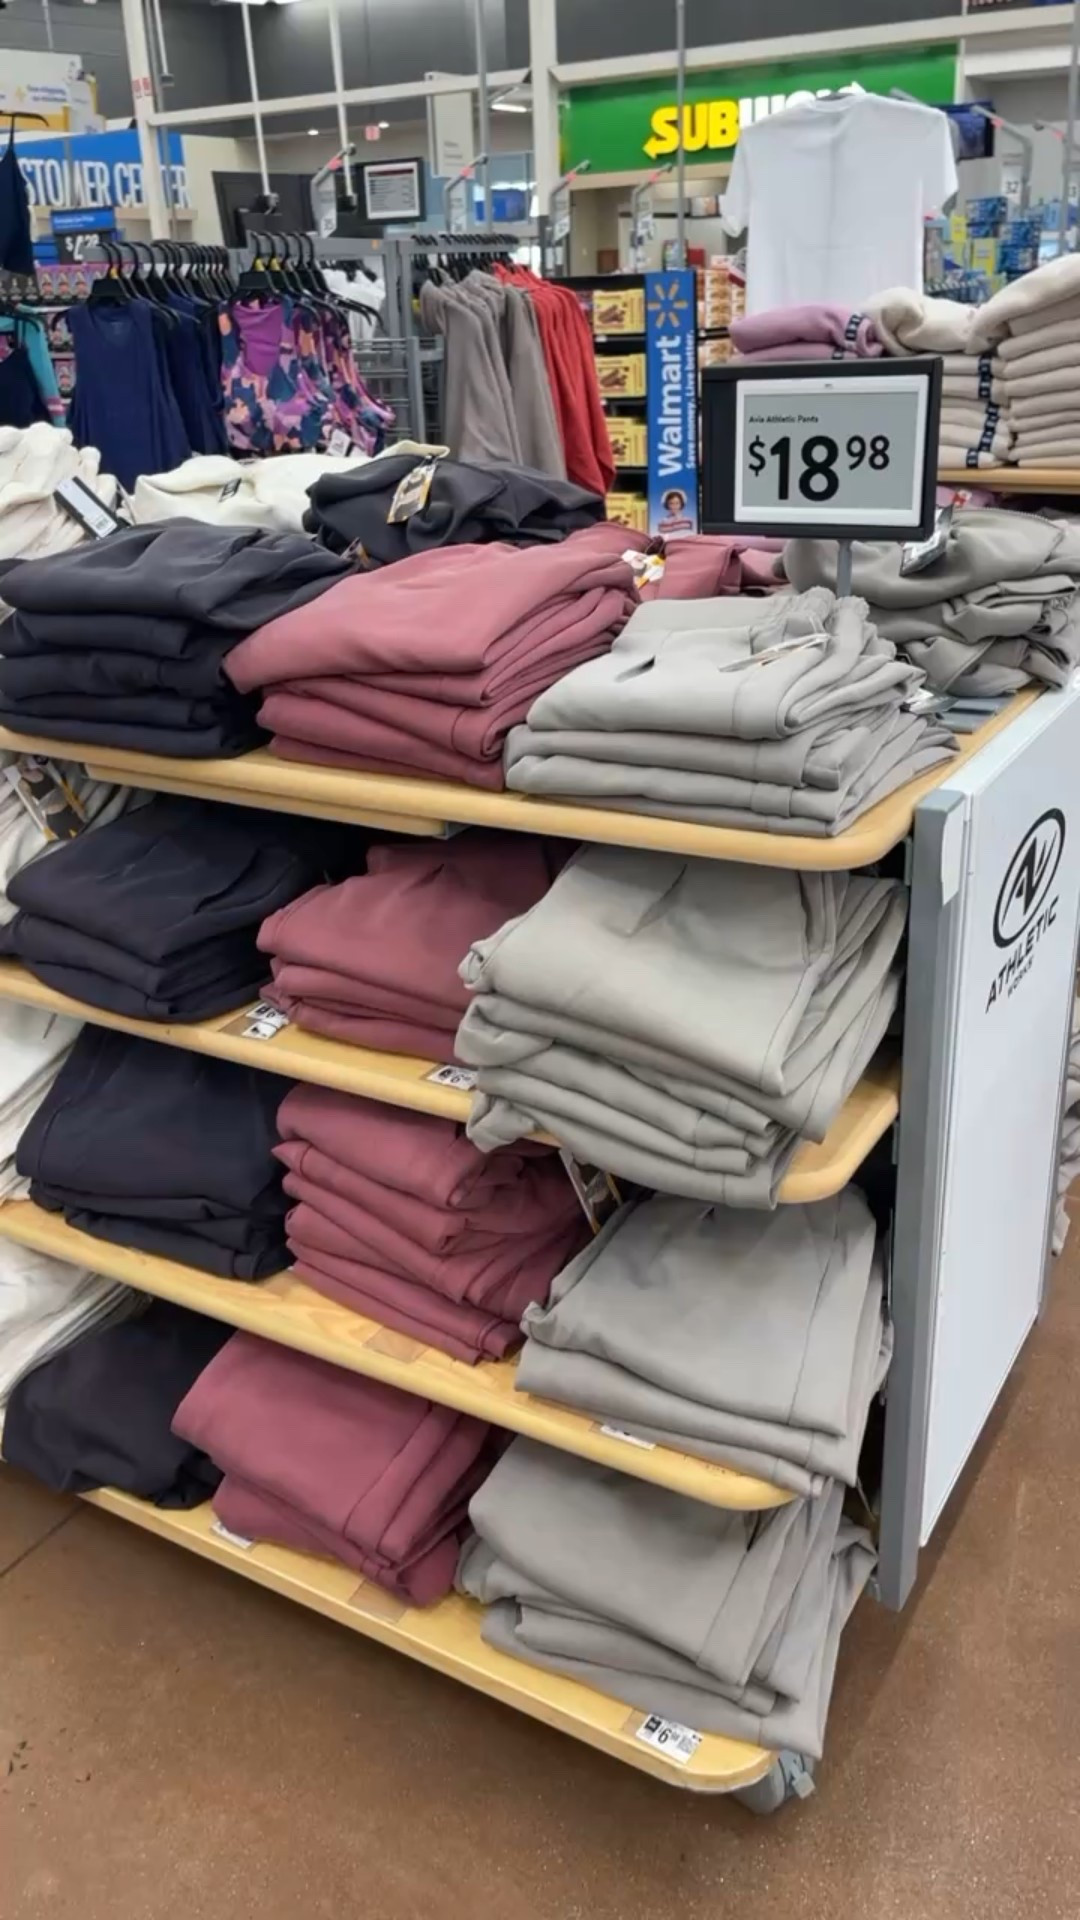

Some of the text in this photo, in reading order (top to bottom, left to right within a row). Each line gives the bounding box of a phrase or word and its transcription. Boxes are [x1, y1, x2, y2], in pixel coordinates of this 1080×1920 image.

[643, 81, 866, 159] SUB
[17, 157, 192, 208] STOMER CEER
[655, 335, 682, 477] Walmart
[684, 329, 697, 469] Save money. Live better.
[748, 414, 819, 424] Avia Athletic Pants
[985, 894, 1060, 1014] ATHLETIC
